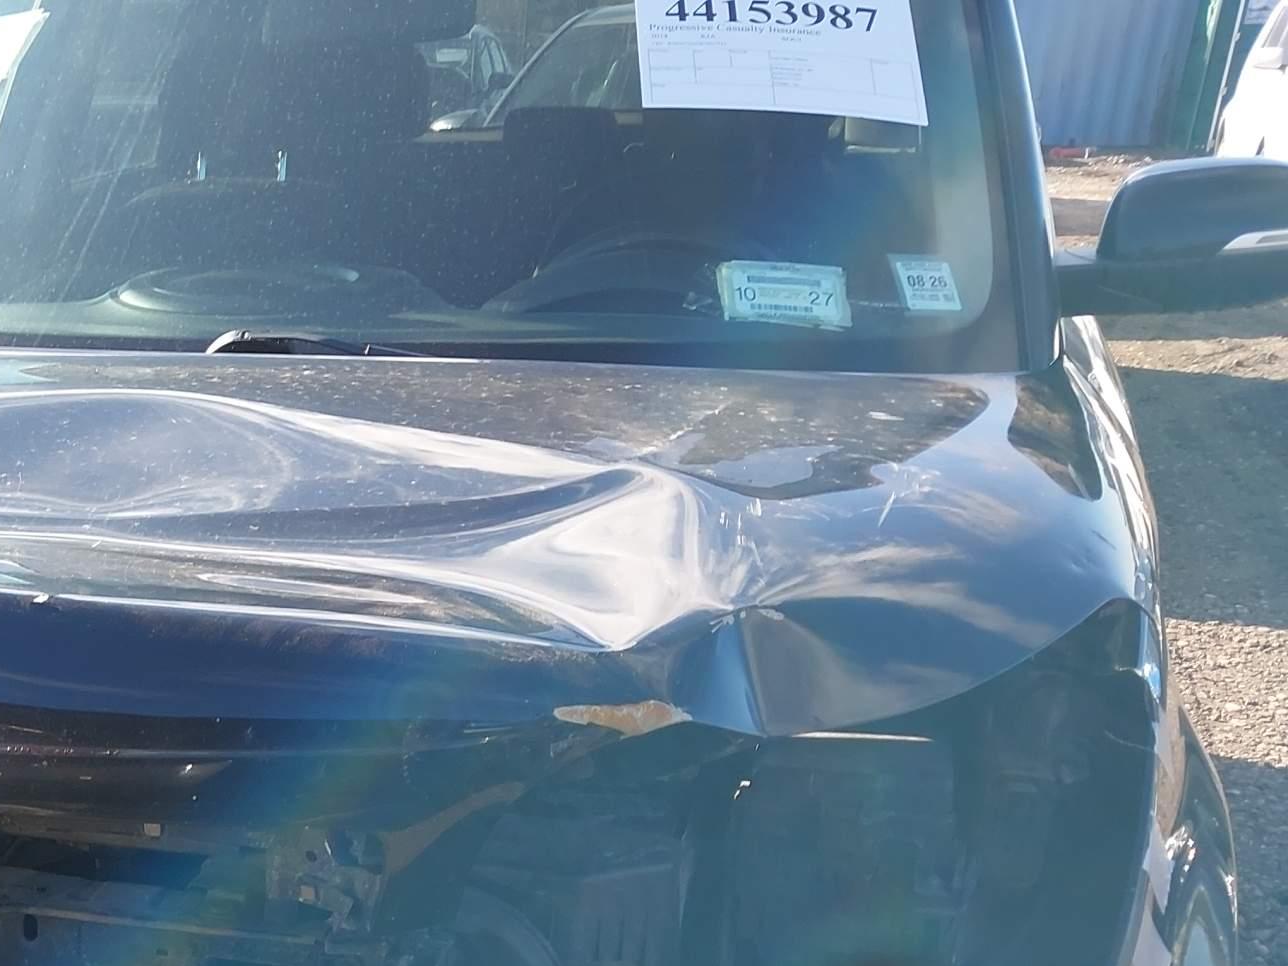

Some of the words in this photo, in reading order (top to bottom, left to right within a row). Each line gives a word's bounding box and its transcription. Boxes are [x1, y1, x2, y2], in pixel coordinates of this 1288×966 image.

[665, 0, 878, 32] 44153987
[648, 23, 714, 33] Progressive
[716, 23, 765, 34] Casualty
[768, 25, 822, 37] Insurance
[906, 274, 926, 288] 08
[735, 286, 757, 302] 10
[808, 290, 834, 307] 27
